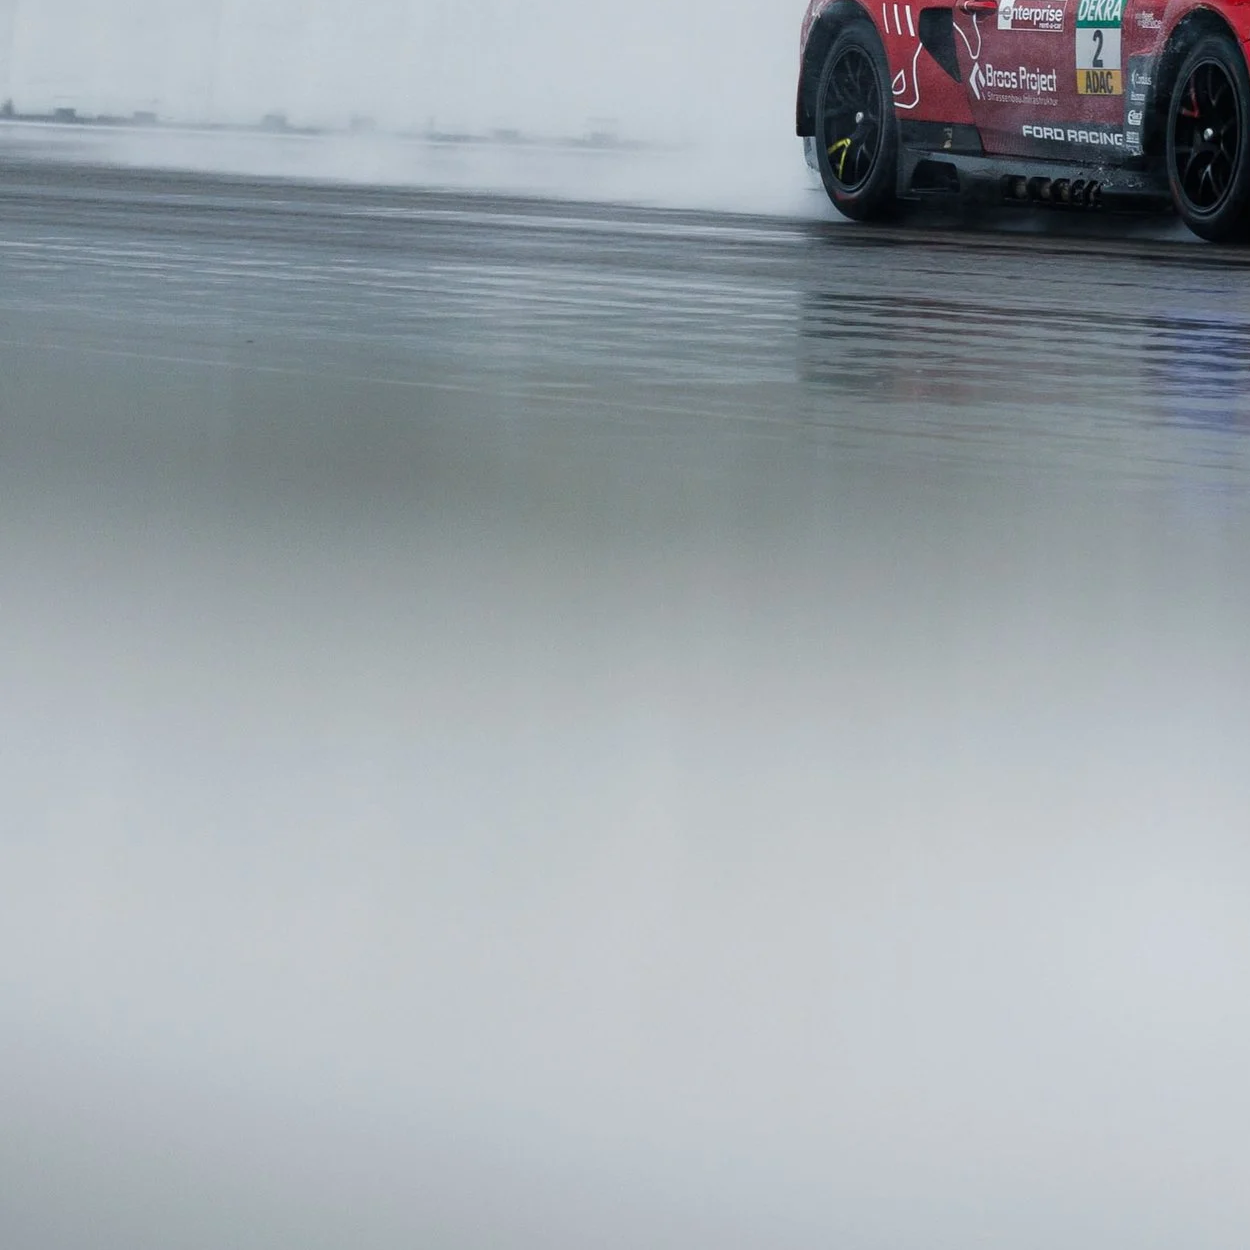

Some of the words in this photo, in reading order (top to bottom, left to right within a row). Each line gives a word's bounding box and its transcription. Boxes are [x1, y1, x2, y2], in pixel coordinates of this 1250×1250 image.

[1002, 4, 1064, 26] enterprise
[1092, 29, 1104, 68] 2
[985, 63, 1017, 89] Broos
[1018, 66, 1057, 95] Project
[1085, 70, 1114, 94] ADAC
[1022, 124, 1065, 141] FORD
[1067, 129, 1124, 146] RACING
